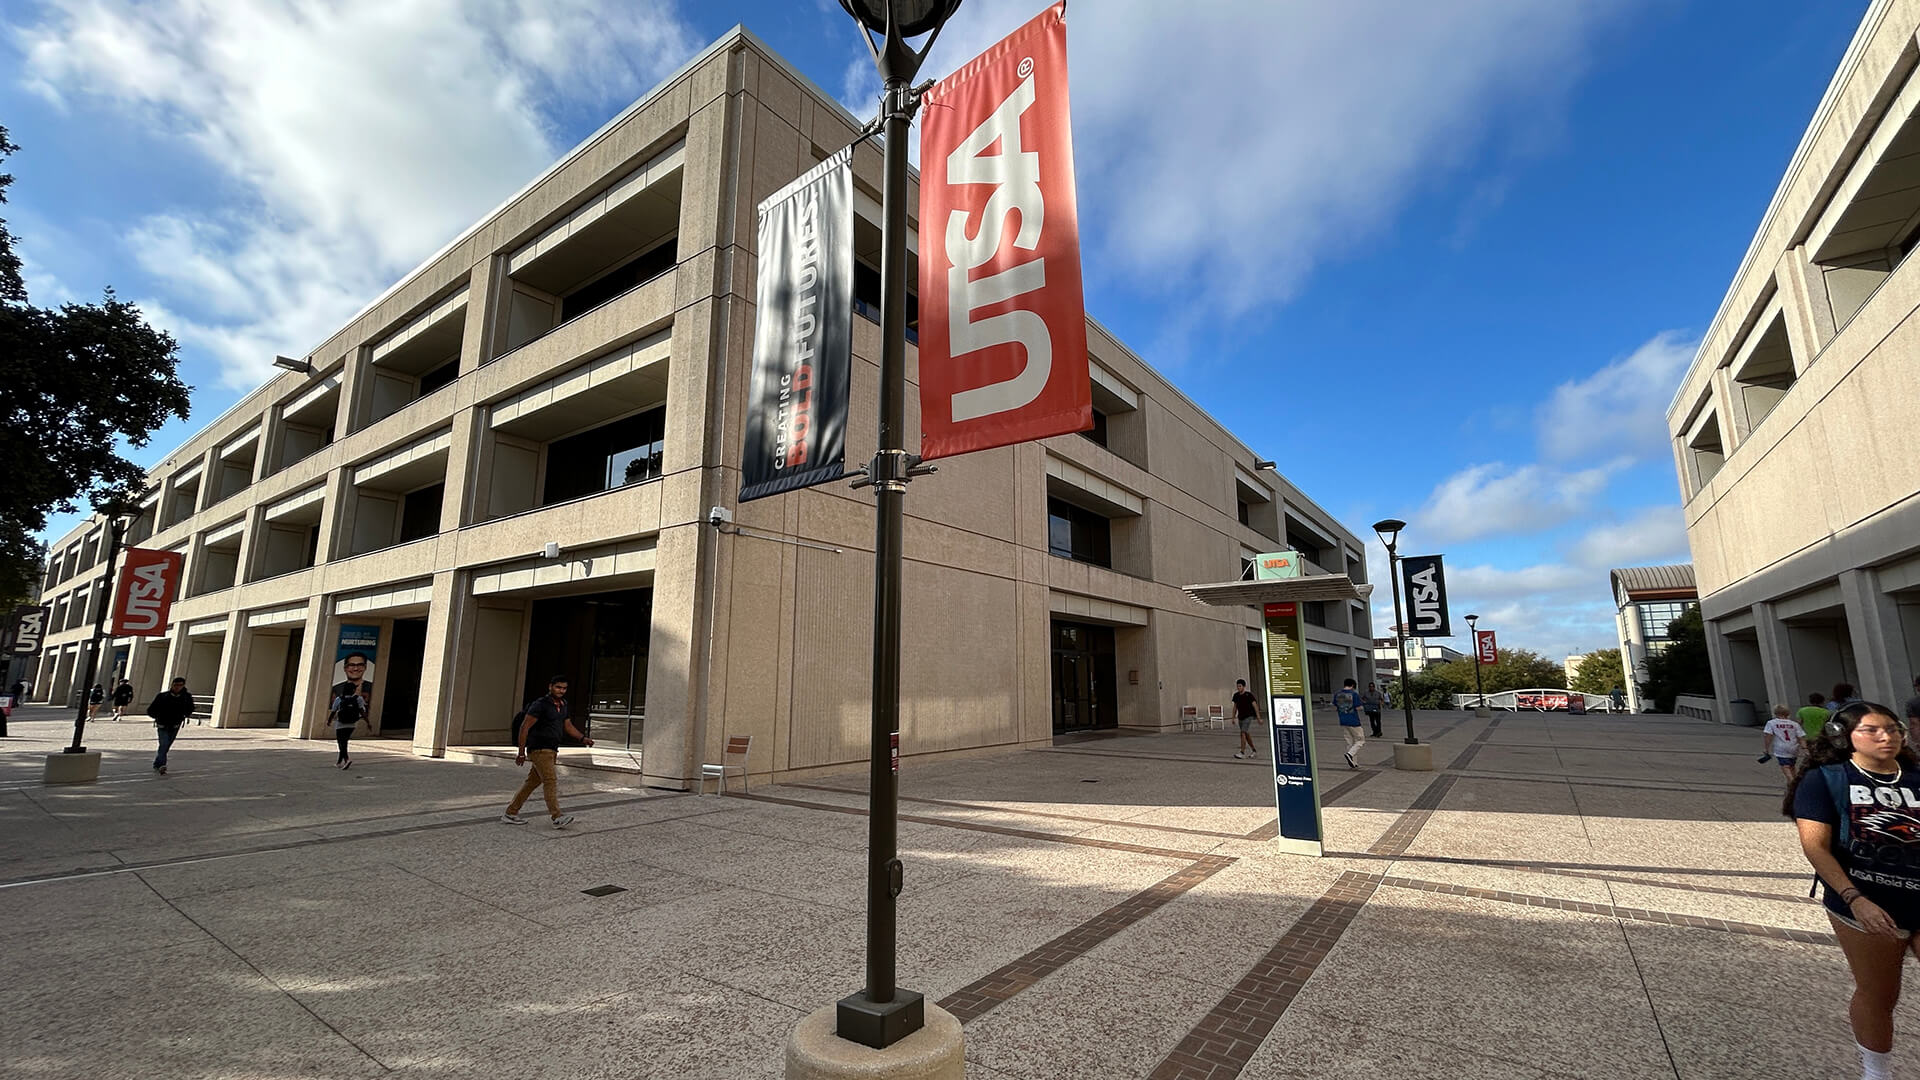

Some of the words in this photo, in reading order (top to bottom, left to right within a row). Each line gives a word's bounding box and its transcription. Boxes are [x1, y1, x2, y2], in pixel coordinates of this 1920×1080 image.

[774, 373, 791, 470] CREATING
[1263, 558, 1290, 569] UTSA
[122, 562, 171, 631] UTSA
[15, 611, 44, 653] UTSA
[1481, 635, 1495, 662] UTSA
[1849, 784, 1920, 808] BOL
[1875, 875, 1903, 888] Bold
